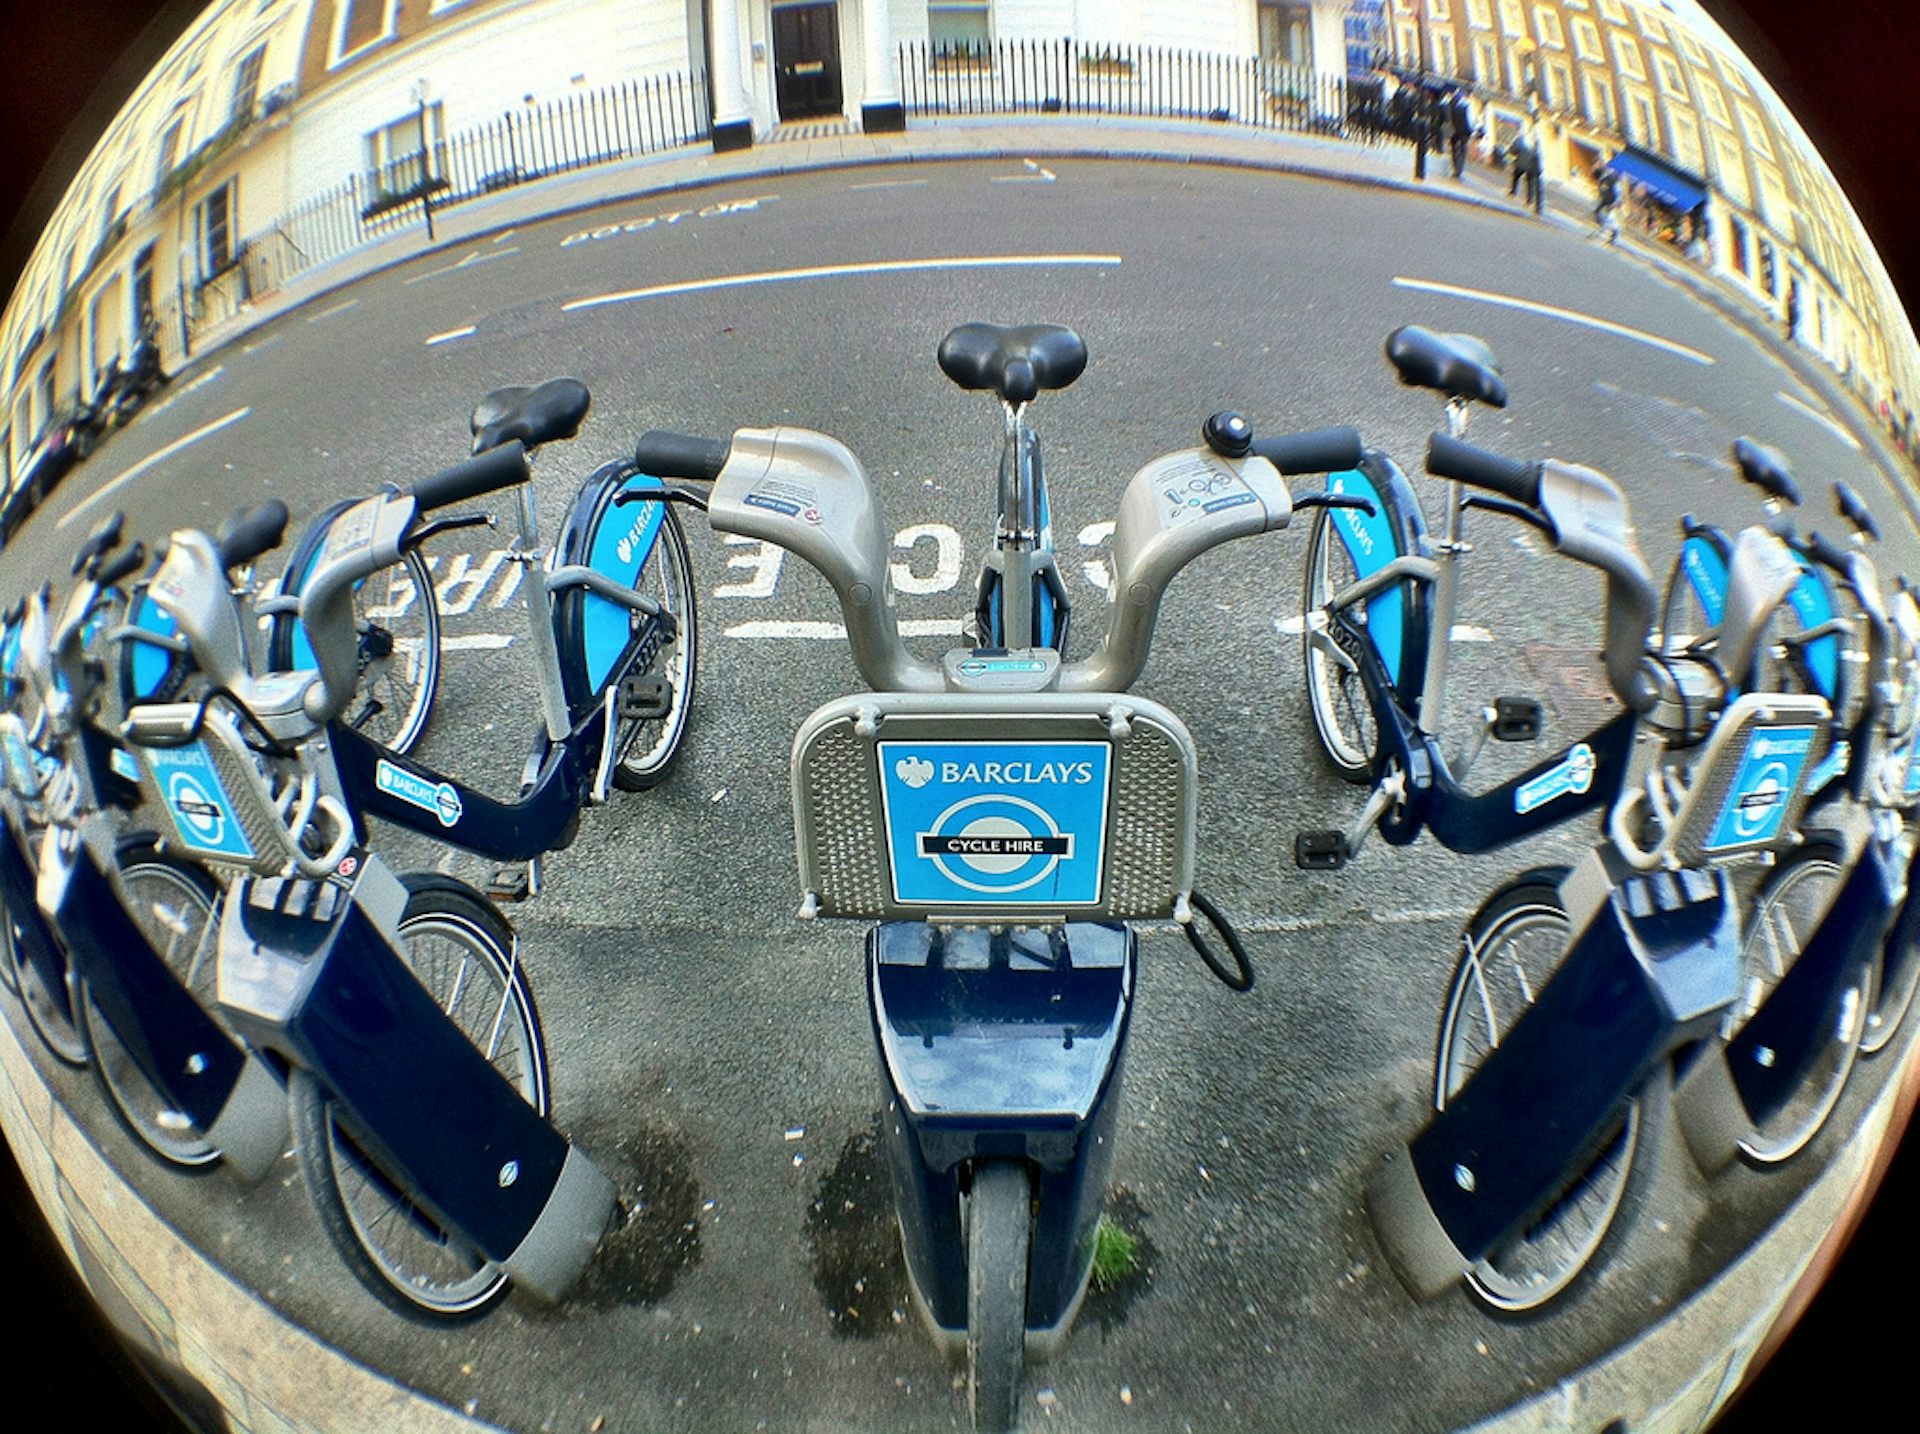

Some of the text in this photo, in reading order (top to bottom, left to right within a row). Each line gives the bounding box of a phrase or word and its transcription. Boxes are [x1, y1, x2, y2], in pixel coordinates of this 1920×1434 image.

[941, 761, 1093, 785] BARCLAYS
[947, 839, 1044, 852] CYCLE HIRE
